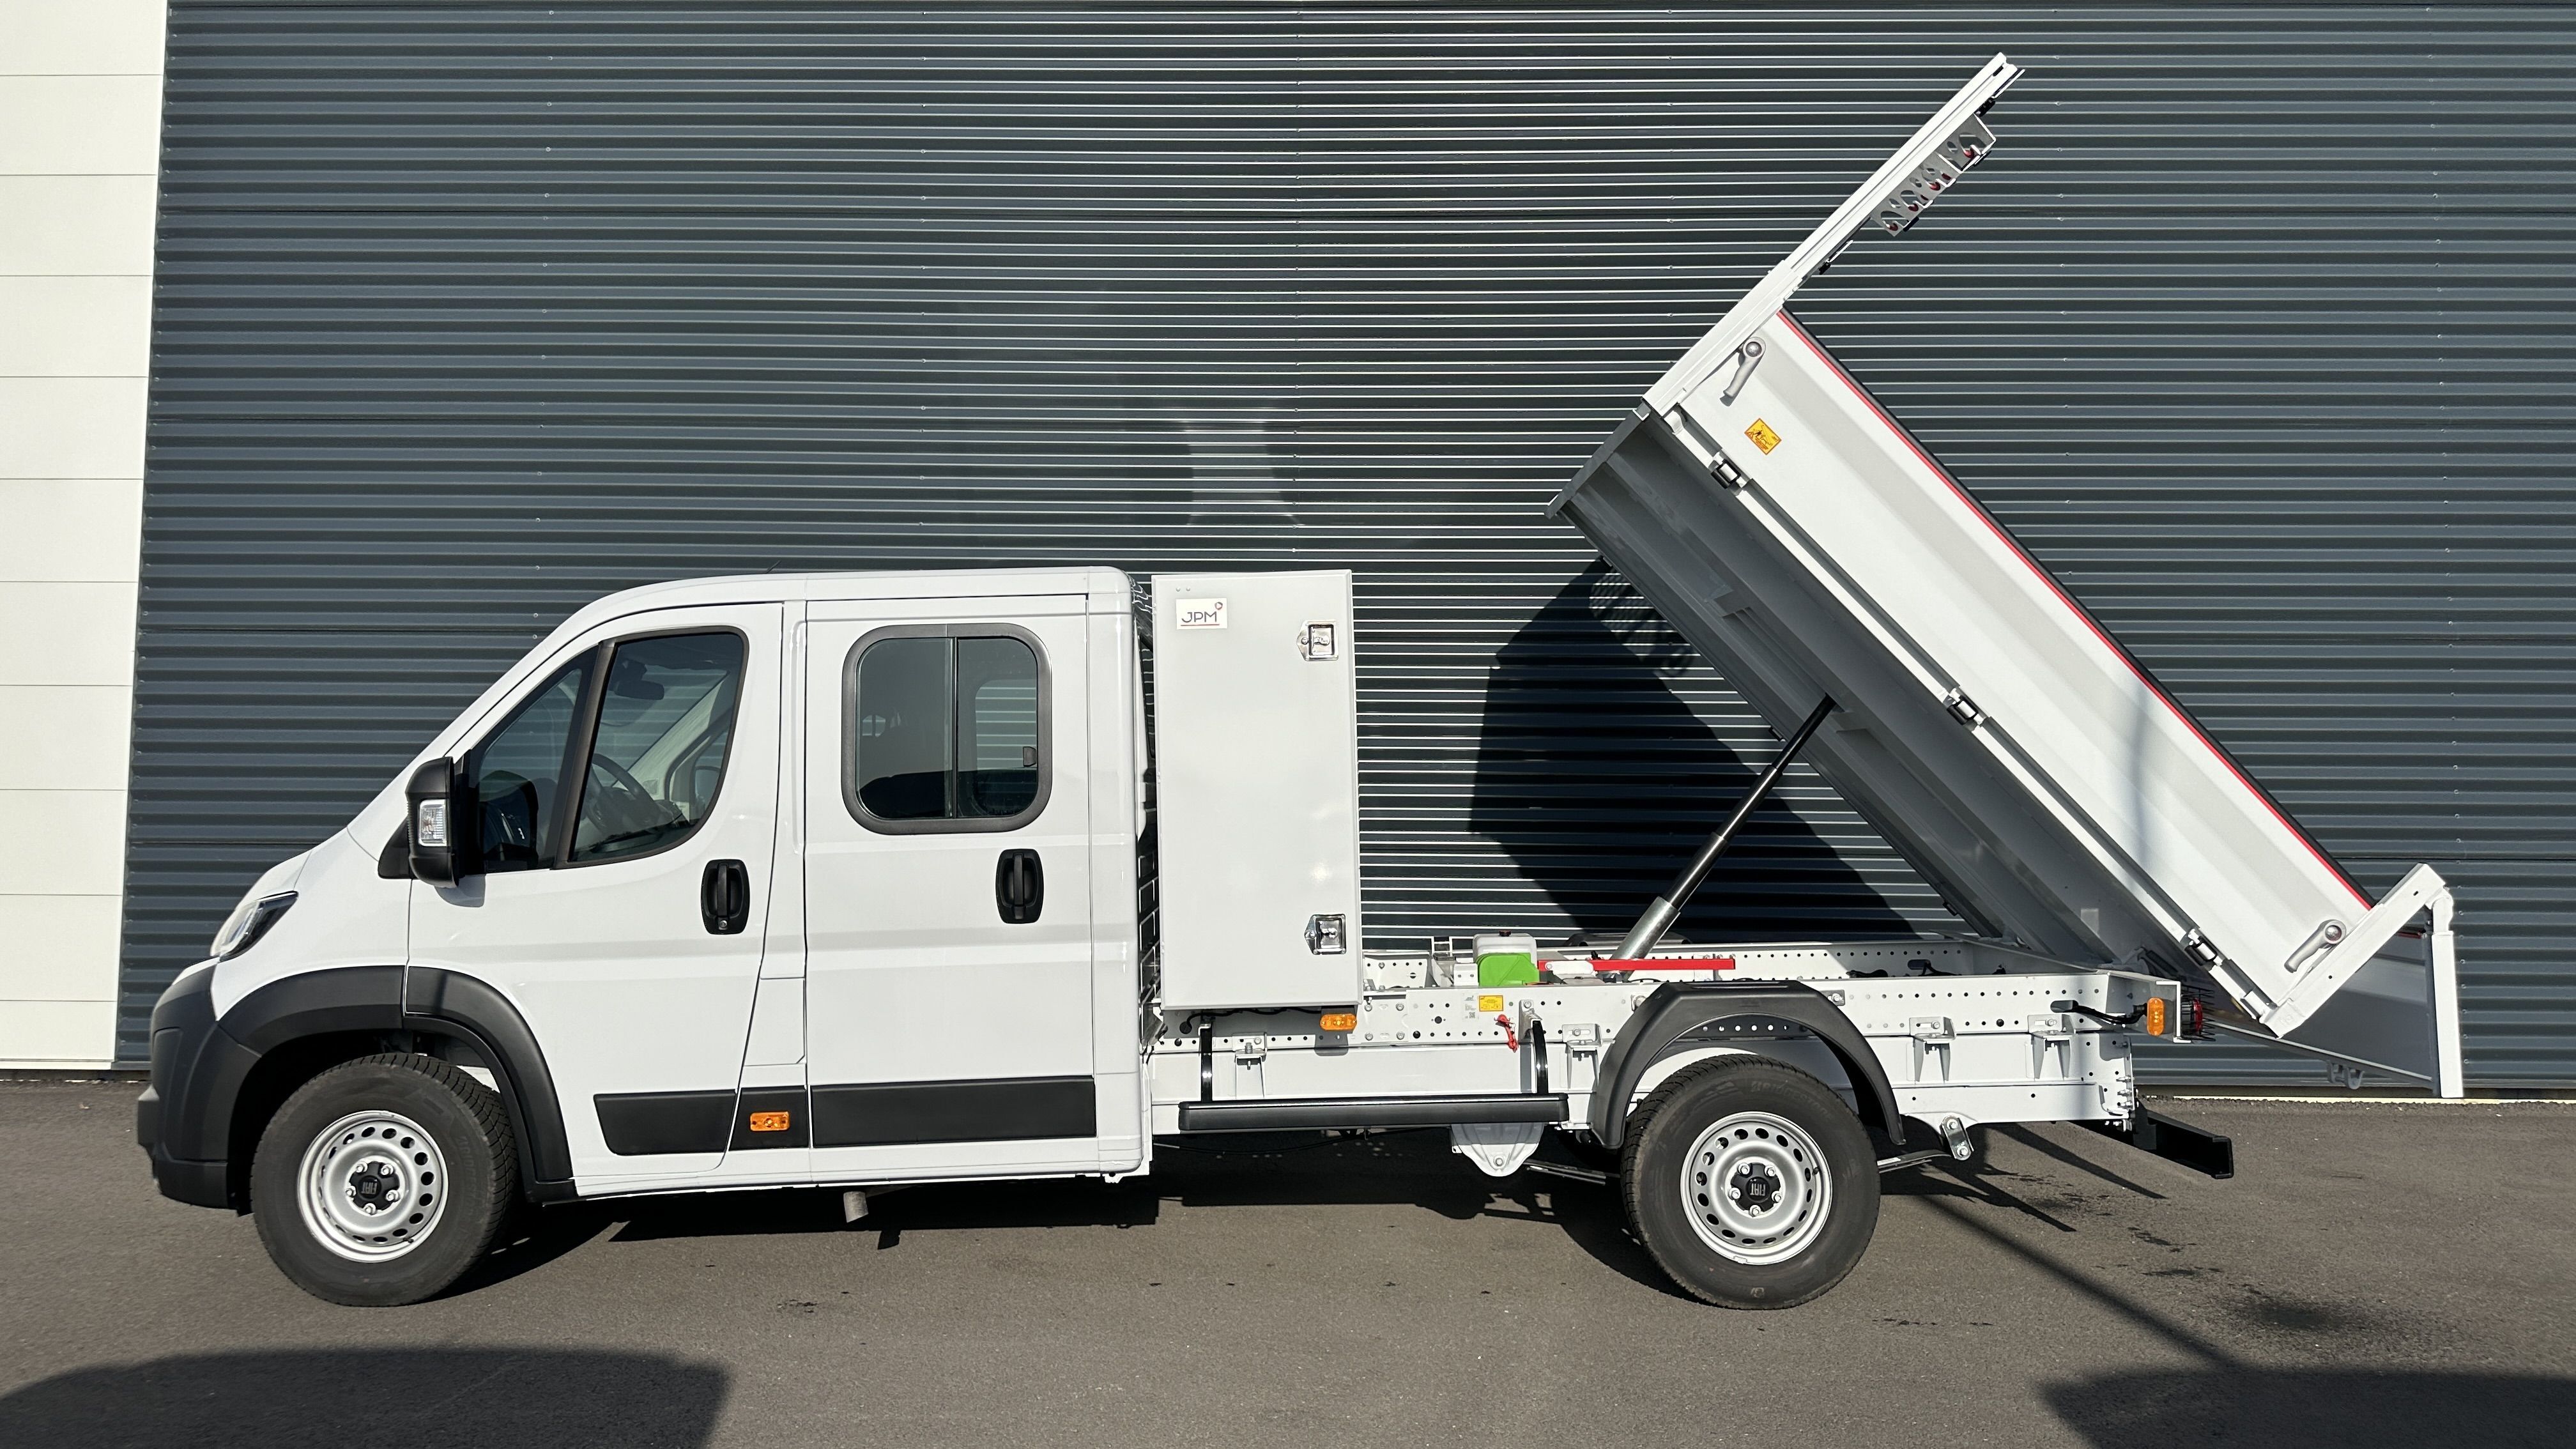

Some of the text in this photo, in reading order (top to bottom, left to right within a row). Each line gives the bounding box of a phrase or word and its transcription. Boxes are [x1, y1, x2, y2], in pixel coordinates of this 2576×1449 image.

[1181, 611, 1217, 623] JPM
[361, 1182, 378, 1194] FIAT
[1750, 1183, 1766, 1196] FIAT
